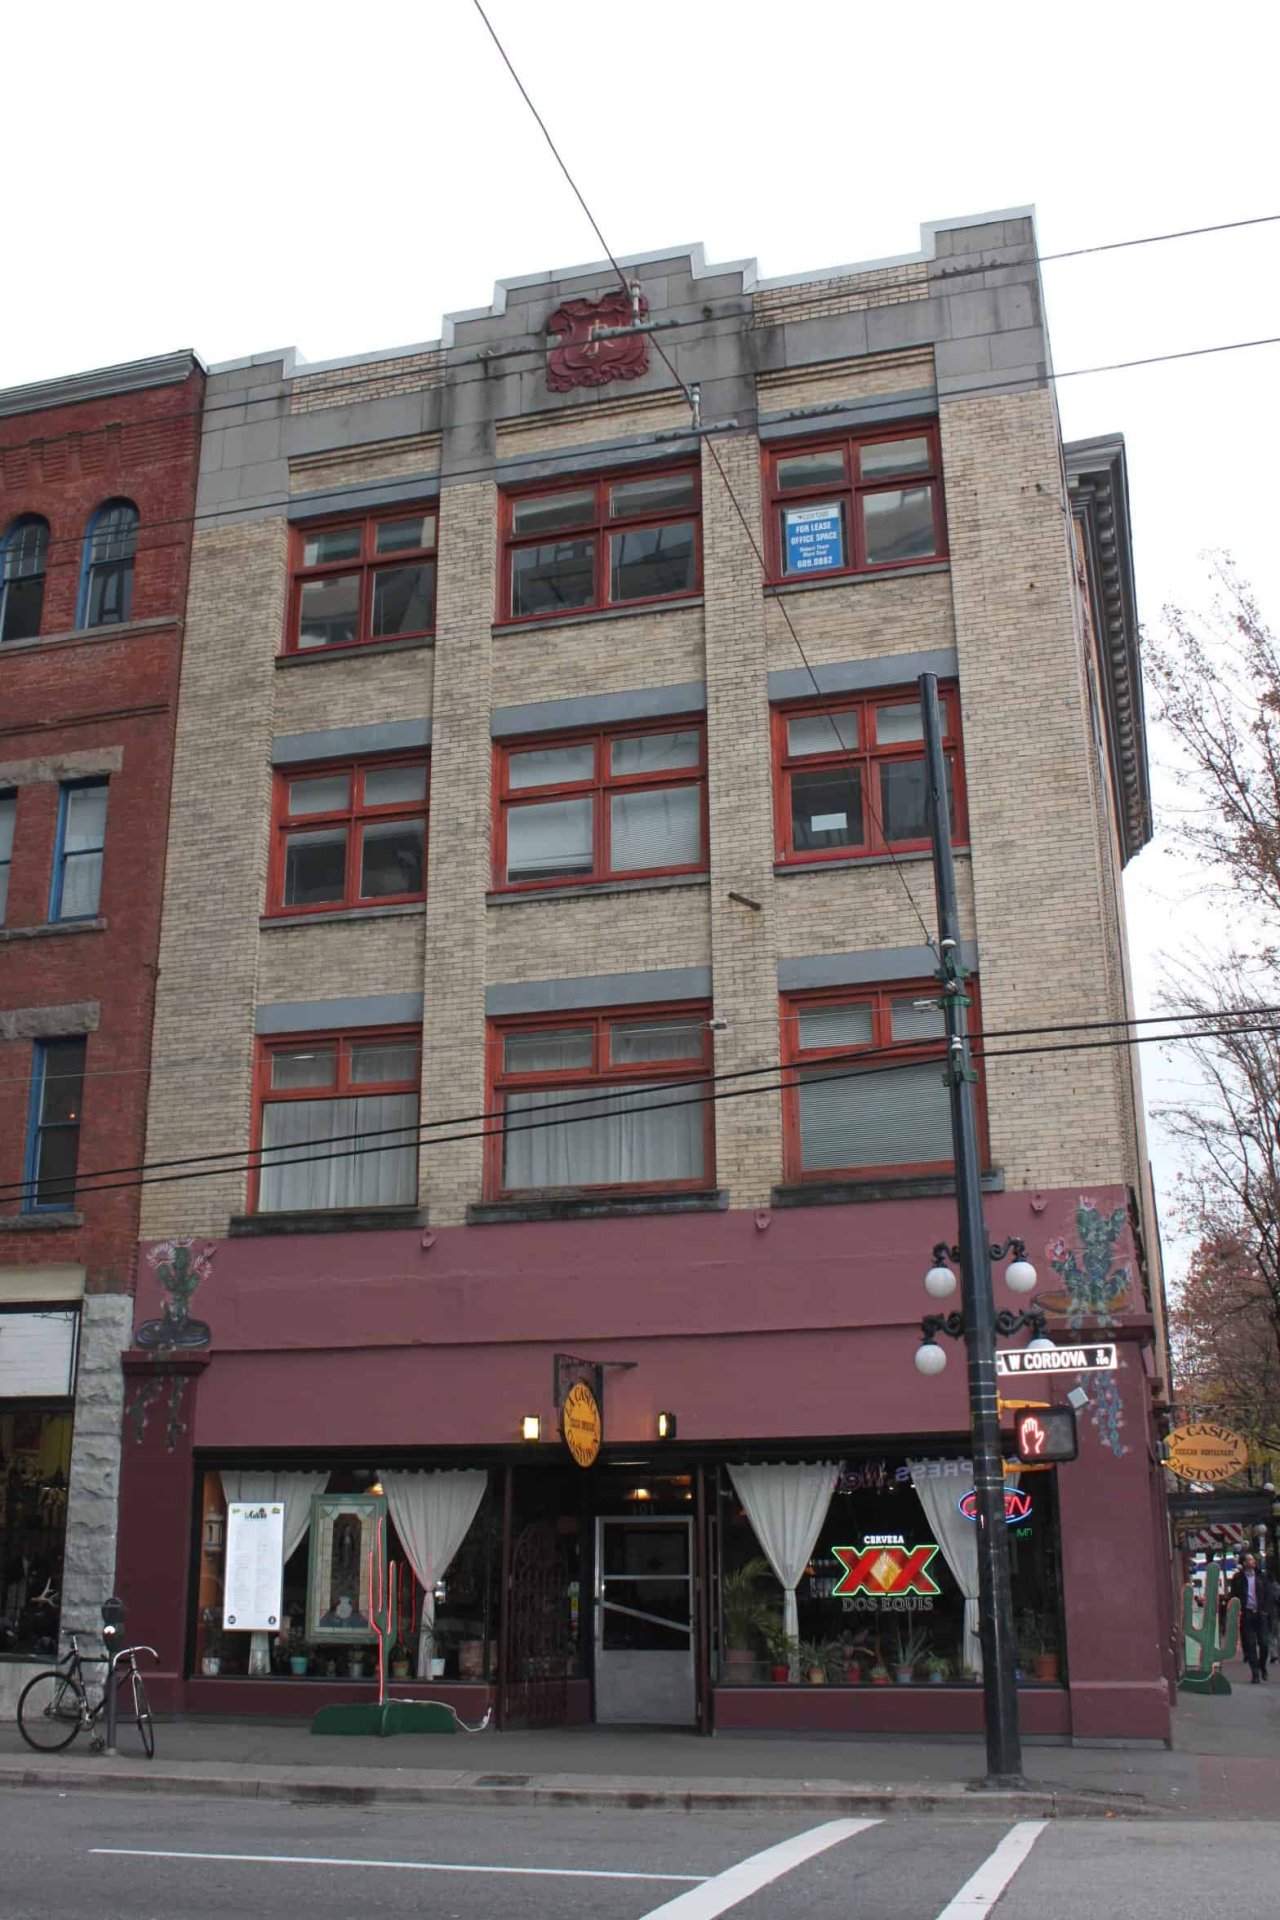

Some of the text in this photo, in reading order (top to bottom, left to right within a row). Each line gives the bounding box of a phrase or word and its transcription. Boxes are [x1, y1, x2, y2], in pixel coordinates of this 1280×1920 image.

[796, 521, 831, 533] FOR LEASE
[791, 531, 837, 545] OFFICE SPACE
[1008, 1354, 1020, 1370] W
[1024, 1351, 1087, 1370] CORDOVA
[1168, 1425, 1238, 1449] LA CASITA
[1168, 1456, 1242, 1480] GASTOWN
[962, 1495, 1031, 1516] ON
[864, 1535, 904, 1544] CERVEZA
[842, 1596, 933, 1612] DOS EQUIS
